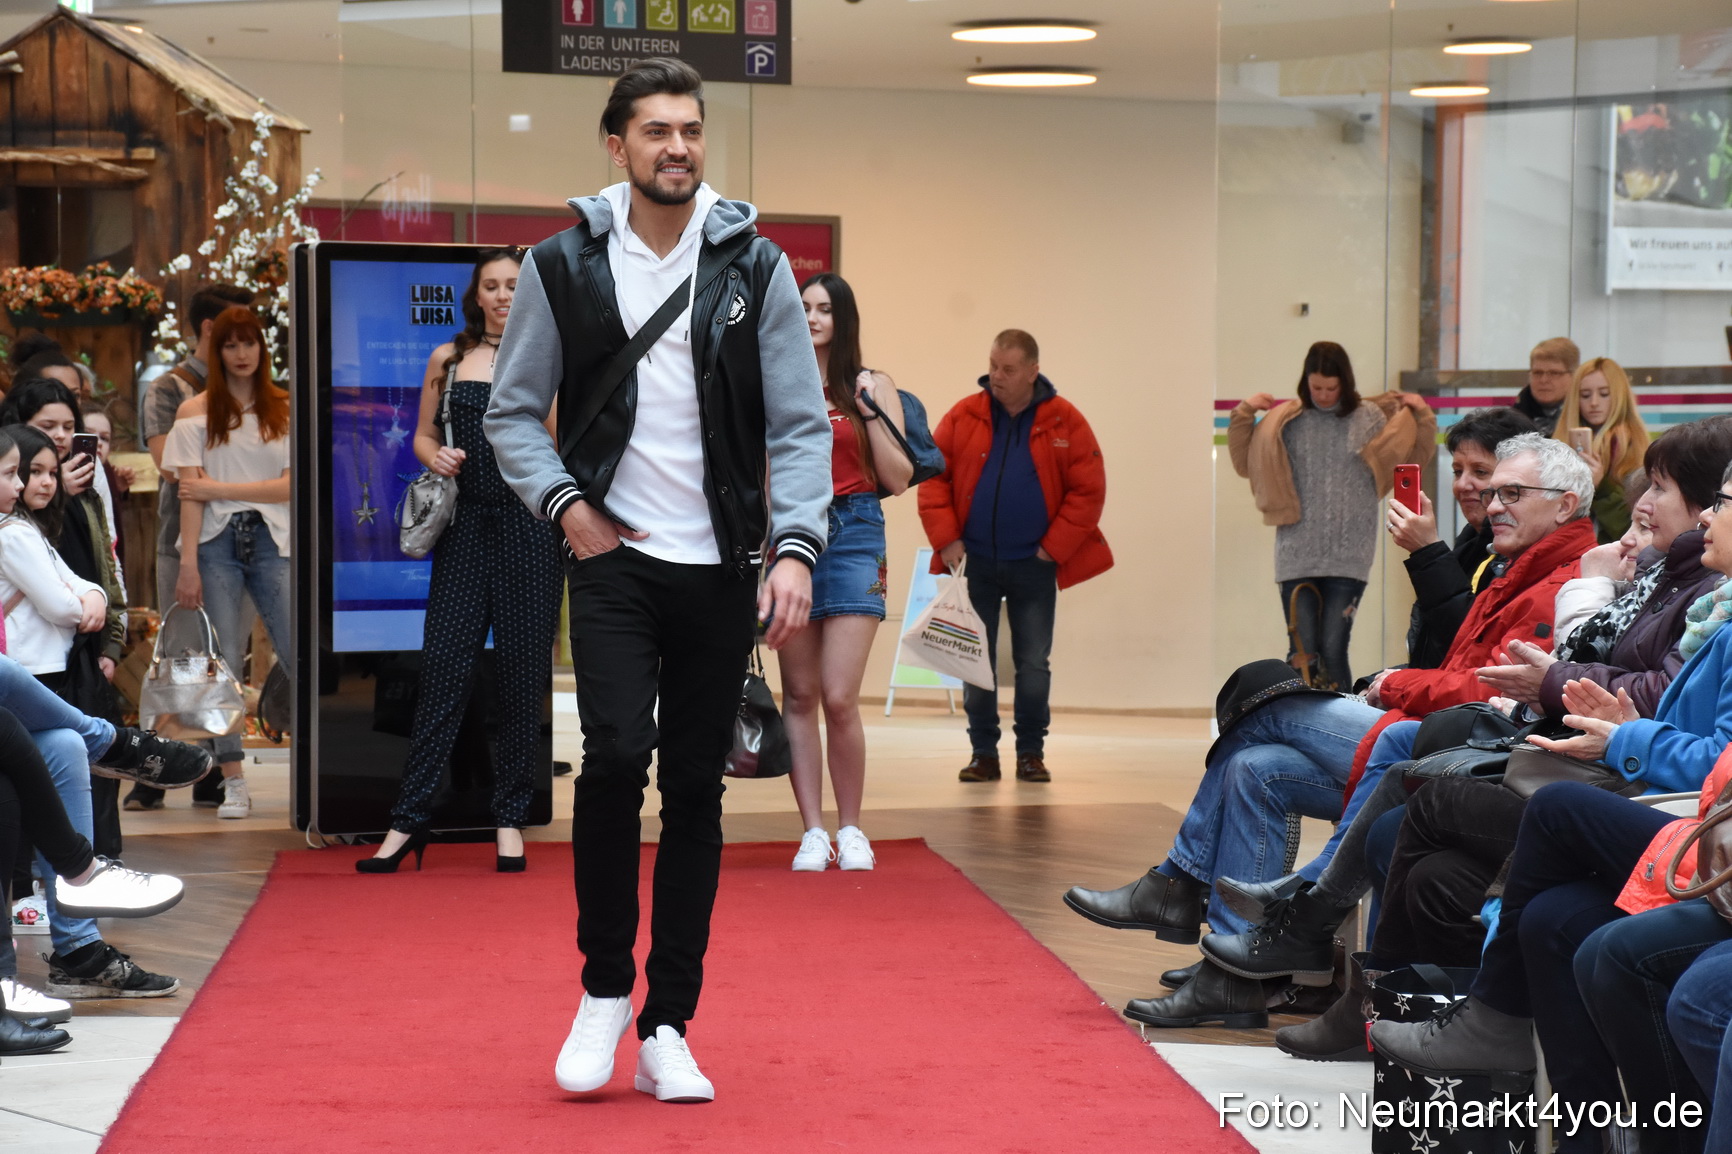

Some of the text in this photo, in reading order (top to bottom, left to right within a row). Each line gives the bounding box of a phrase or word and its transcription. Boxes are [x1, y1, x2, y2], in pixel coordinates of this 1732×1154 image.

[561, 35, 680, 54] IN DER UNTEREN
[754, 53, 769, 74] P
[1629, 238, 1647, 249] Wir
[1650, 237, 1690, 250] freuen
[1692, 240, 1713, 250] uns
[411, 285, 454, 303] LUISA
[411, 307, 454, 325] LUISA
[921, 631, 982, 657] NeuerMarkt
